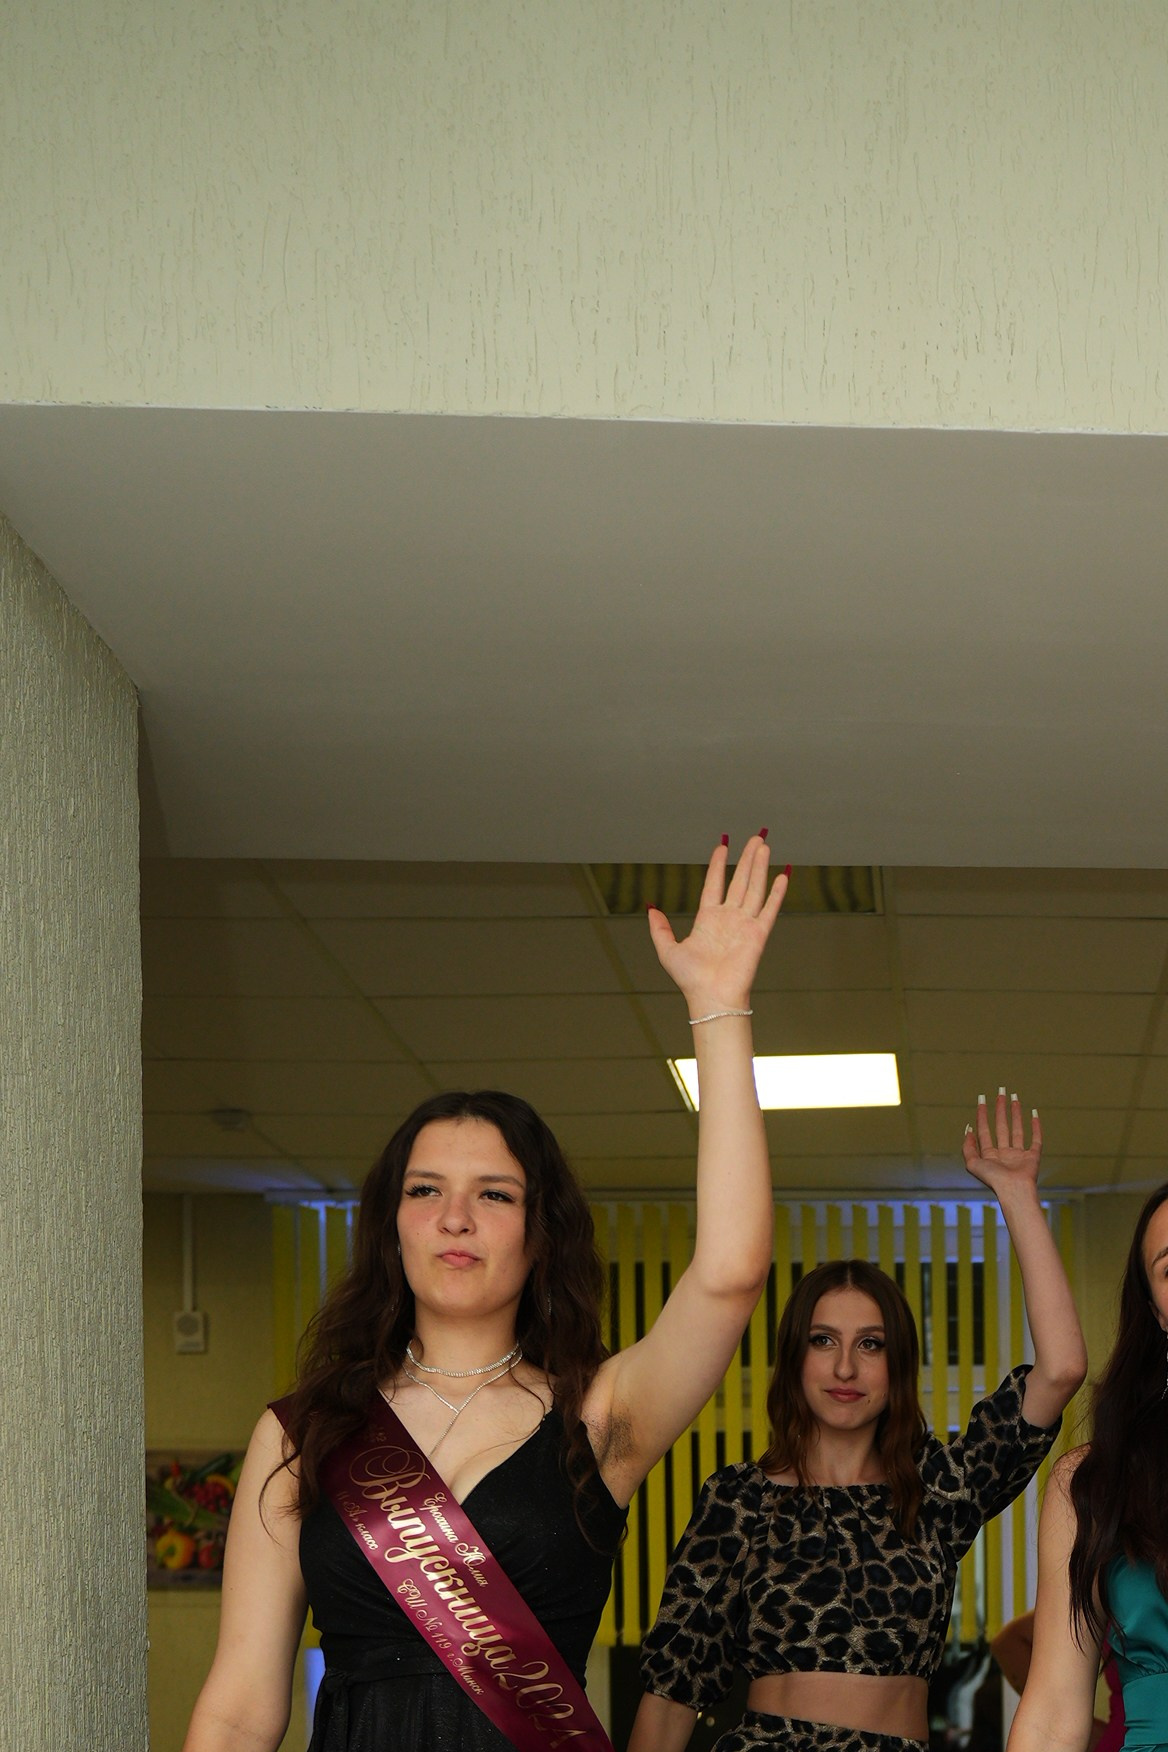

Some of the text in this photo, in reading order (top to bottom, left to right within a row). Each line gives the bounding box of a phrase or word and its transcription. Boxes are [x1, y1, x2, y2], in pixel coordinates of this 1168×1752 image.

[349, 1445, 518, 1670] Выпускница
[355, 1522, 378, 1550] класс
[419, 1492, 489, 1587] Ерохина Юлия
[432, 1633, 452, 1649] 119
